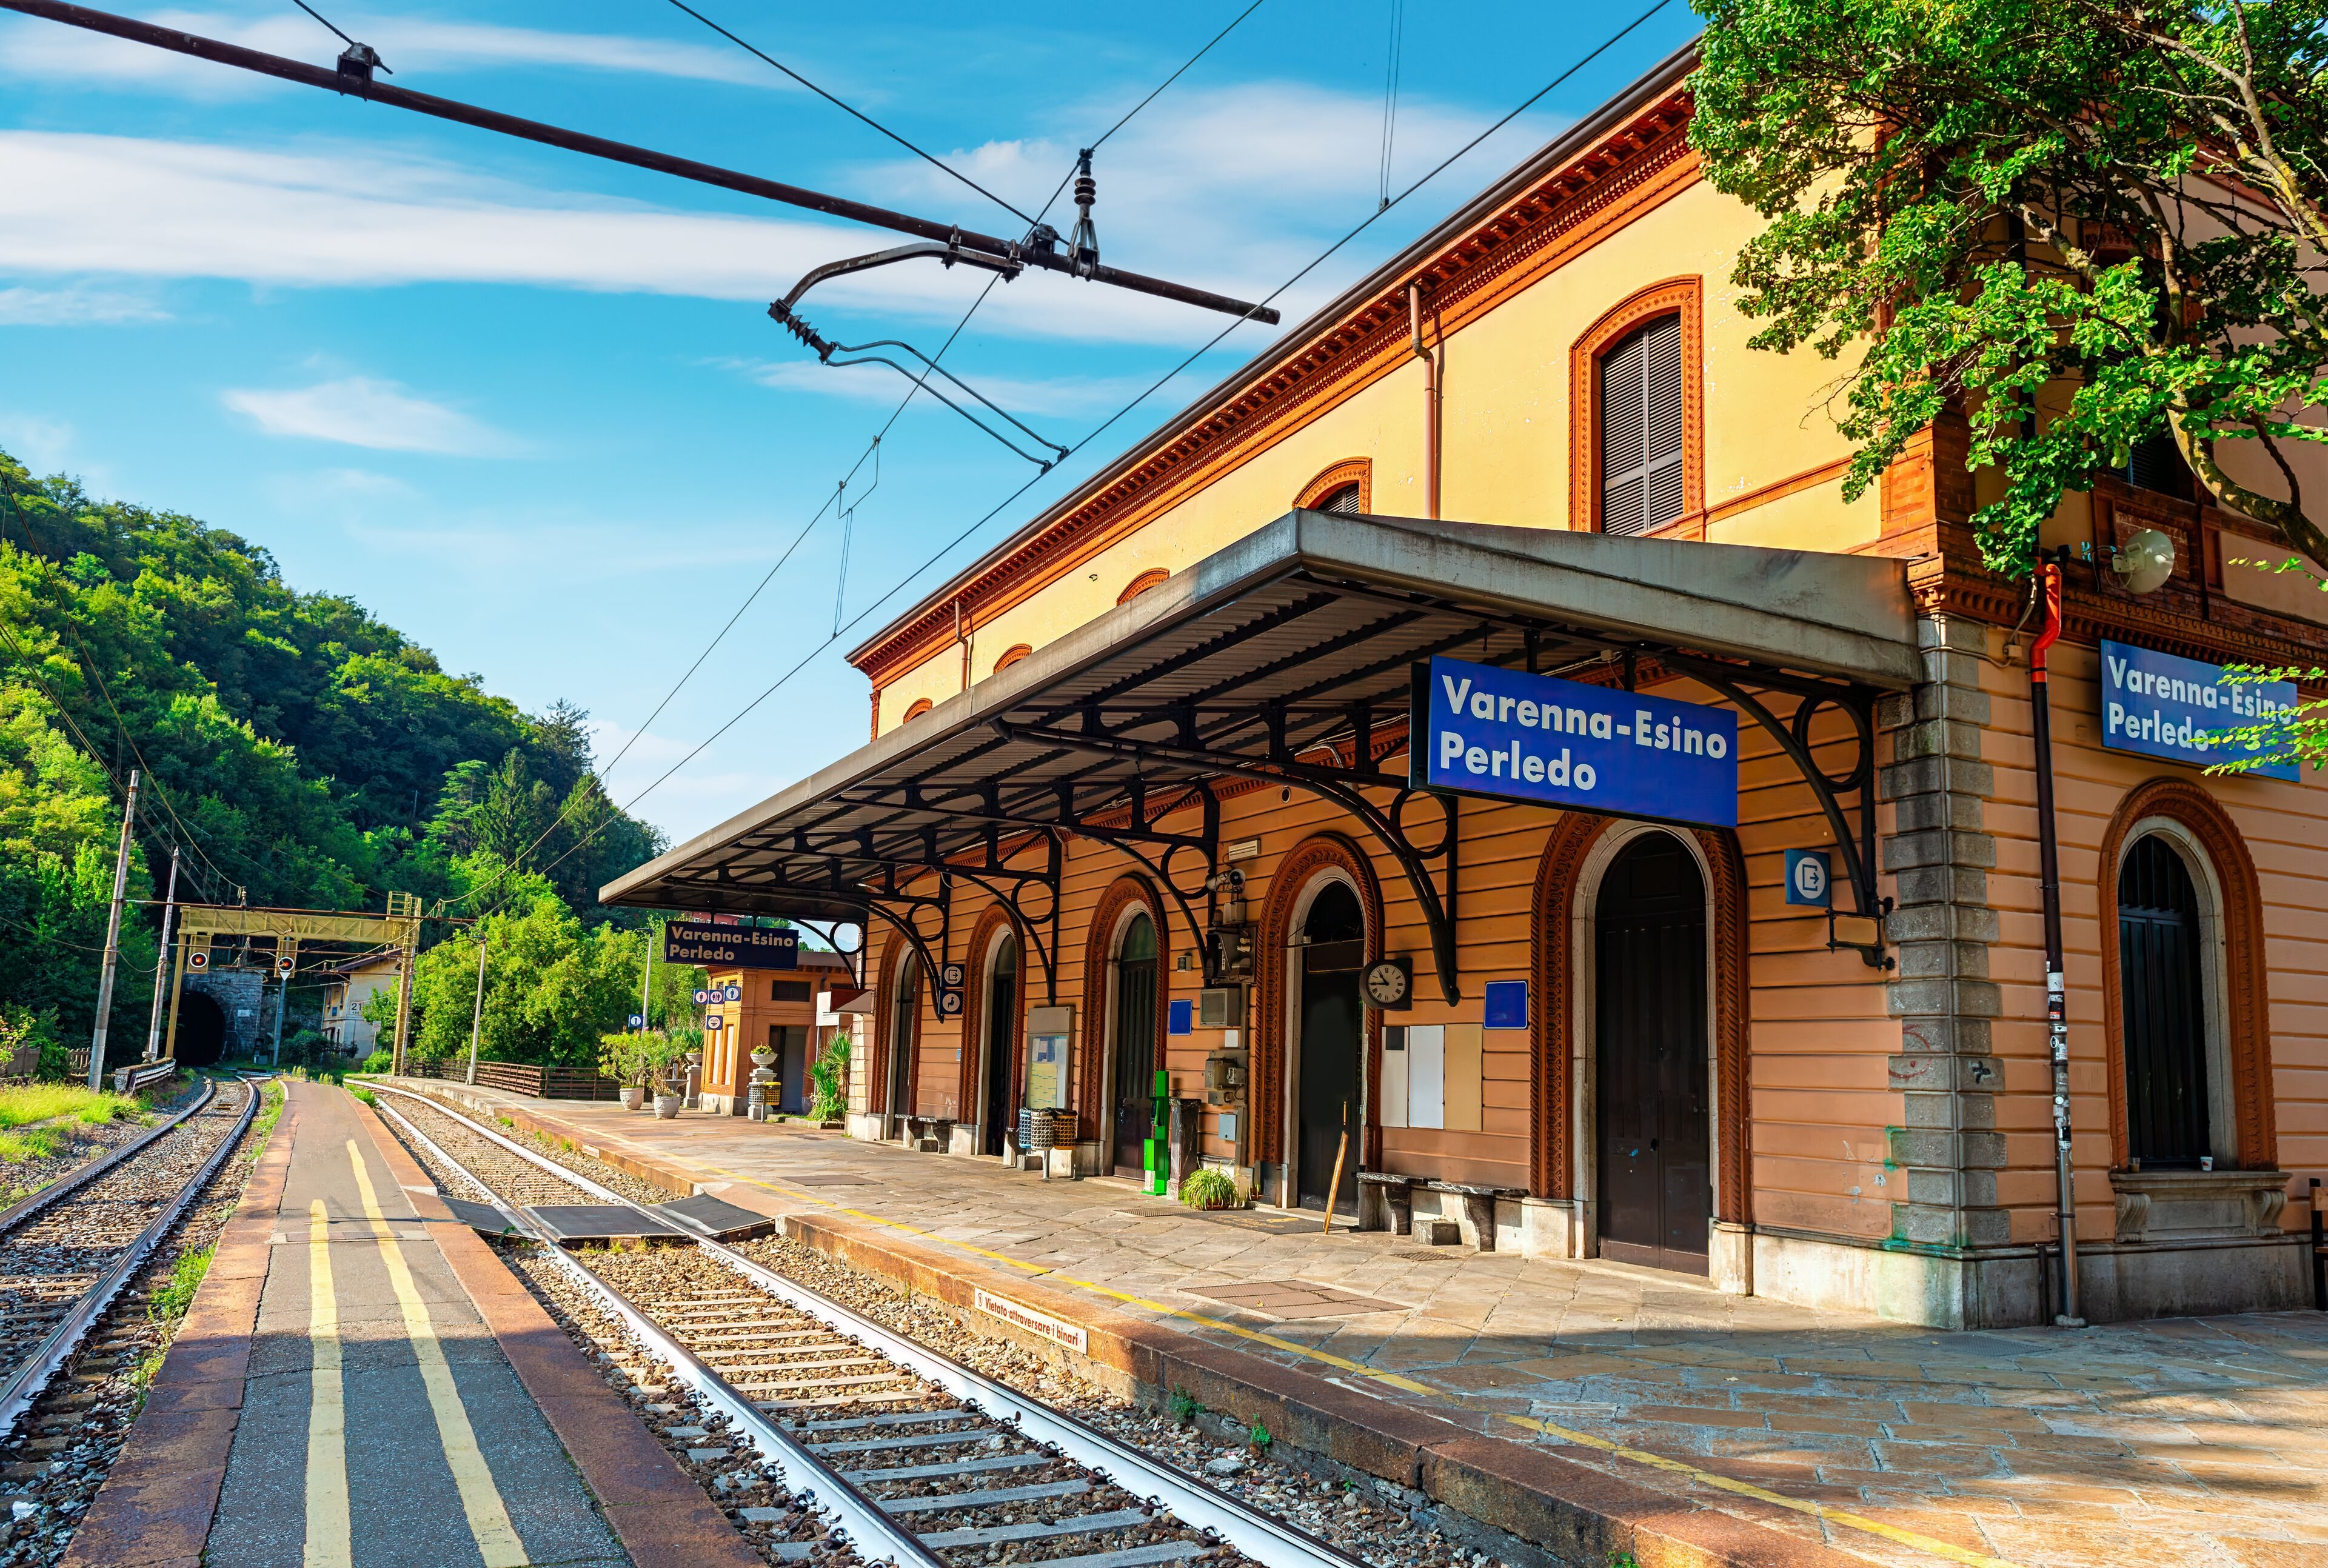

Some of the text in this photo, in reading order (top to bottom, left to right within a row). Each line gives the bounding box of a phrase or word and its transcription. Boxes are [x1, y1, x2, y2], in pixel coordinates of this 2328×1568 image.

[2108, 655, 2292, 725] Varenna-Esino
[1442, 675, 1727, 759] Varenna-Esino
[2109, 702, 2209, 752] Perledo
[1440, 730, 1597, 790] Perledo
[669, 944, 735, 961] Perledo
[671, 926, 794, 947] Varenna-Esino
[351, 1003, 362, 1011] 21
[985, 1296, 1078, 1346] Vietato attraversare i binari
